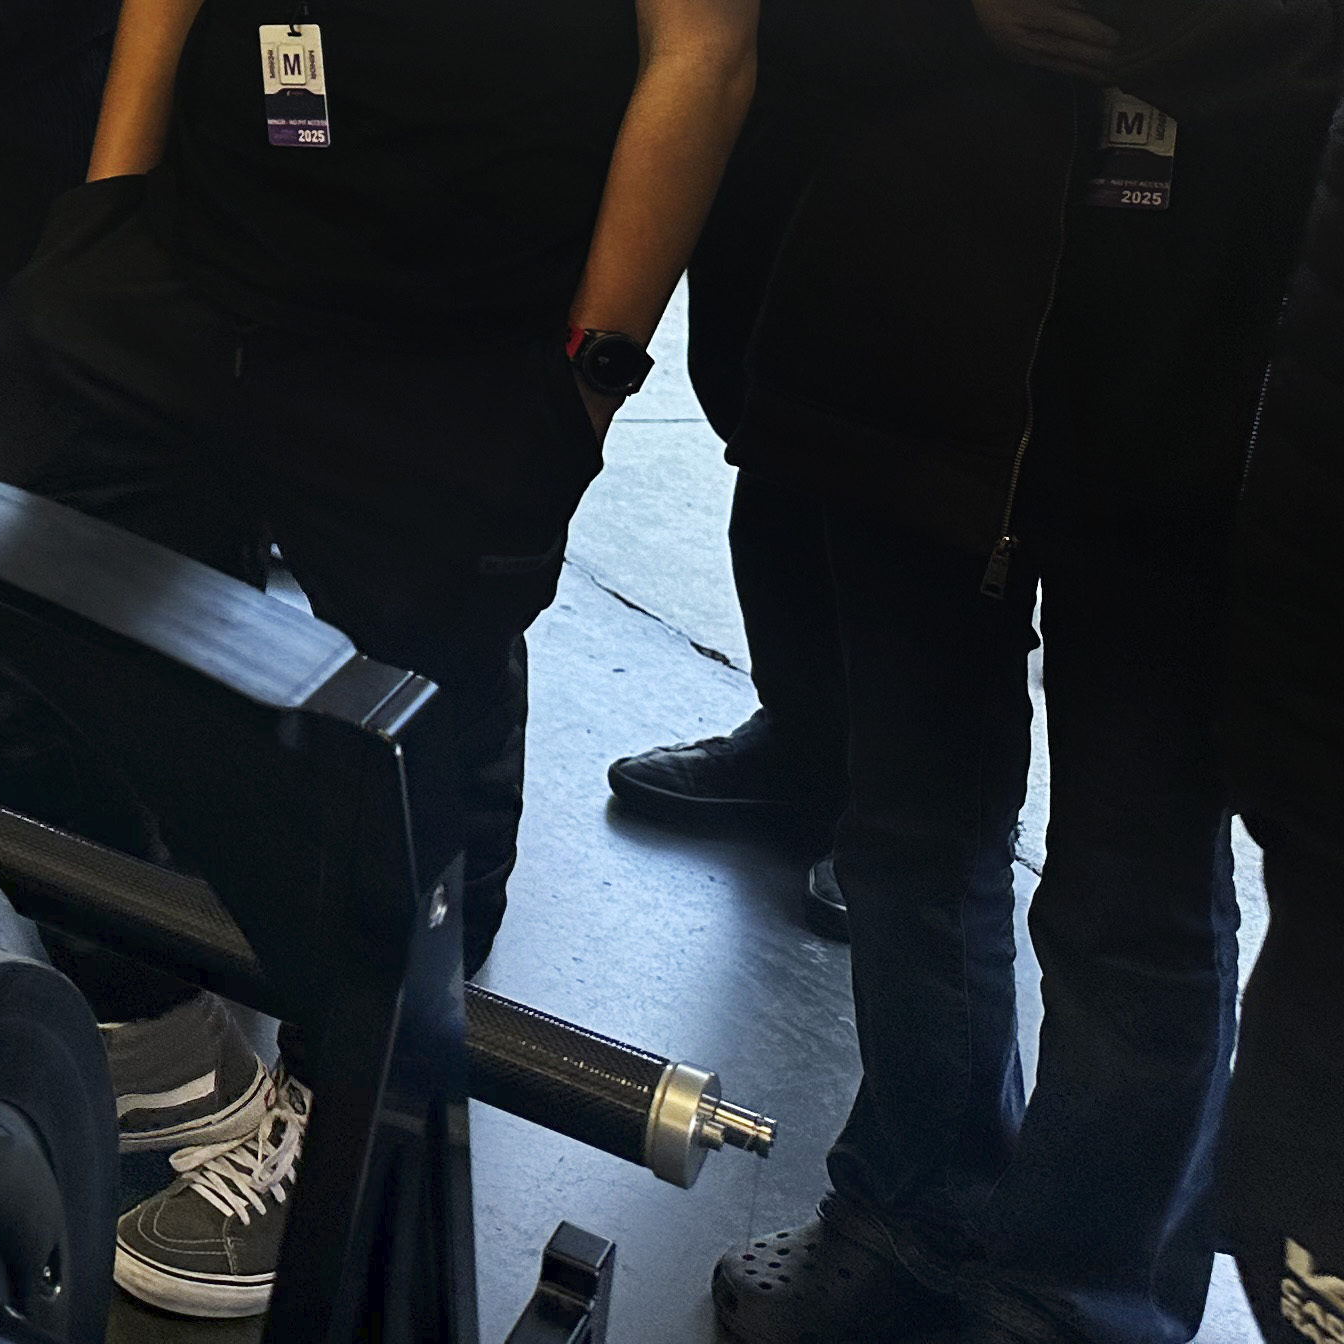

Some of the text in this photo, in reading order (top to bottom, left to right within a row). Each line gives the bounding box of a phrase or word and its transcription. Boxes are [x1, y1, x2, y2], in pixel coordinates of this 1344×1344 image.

[283, 53, 302, 76] M
[1115, 111, 1145, 136] M
[297, 129, 326, 143] 2025
[1120, 190, 1163, 206] 2025
